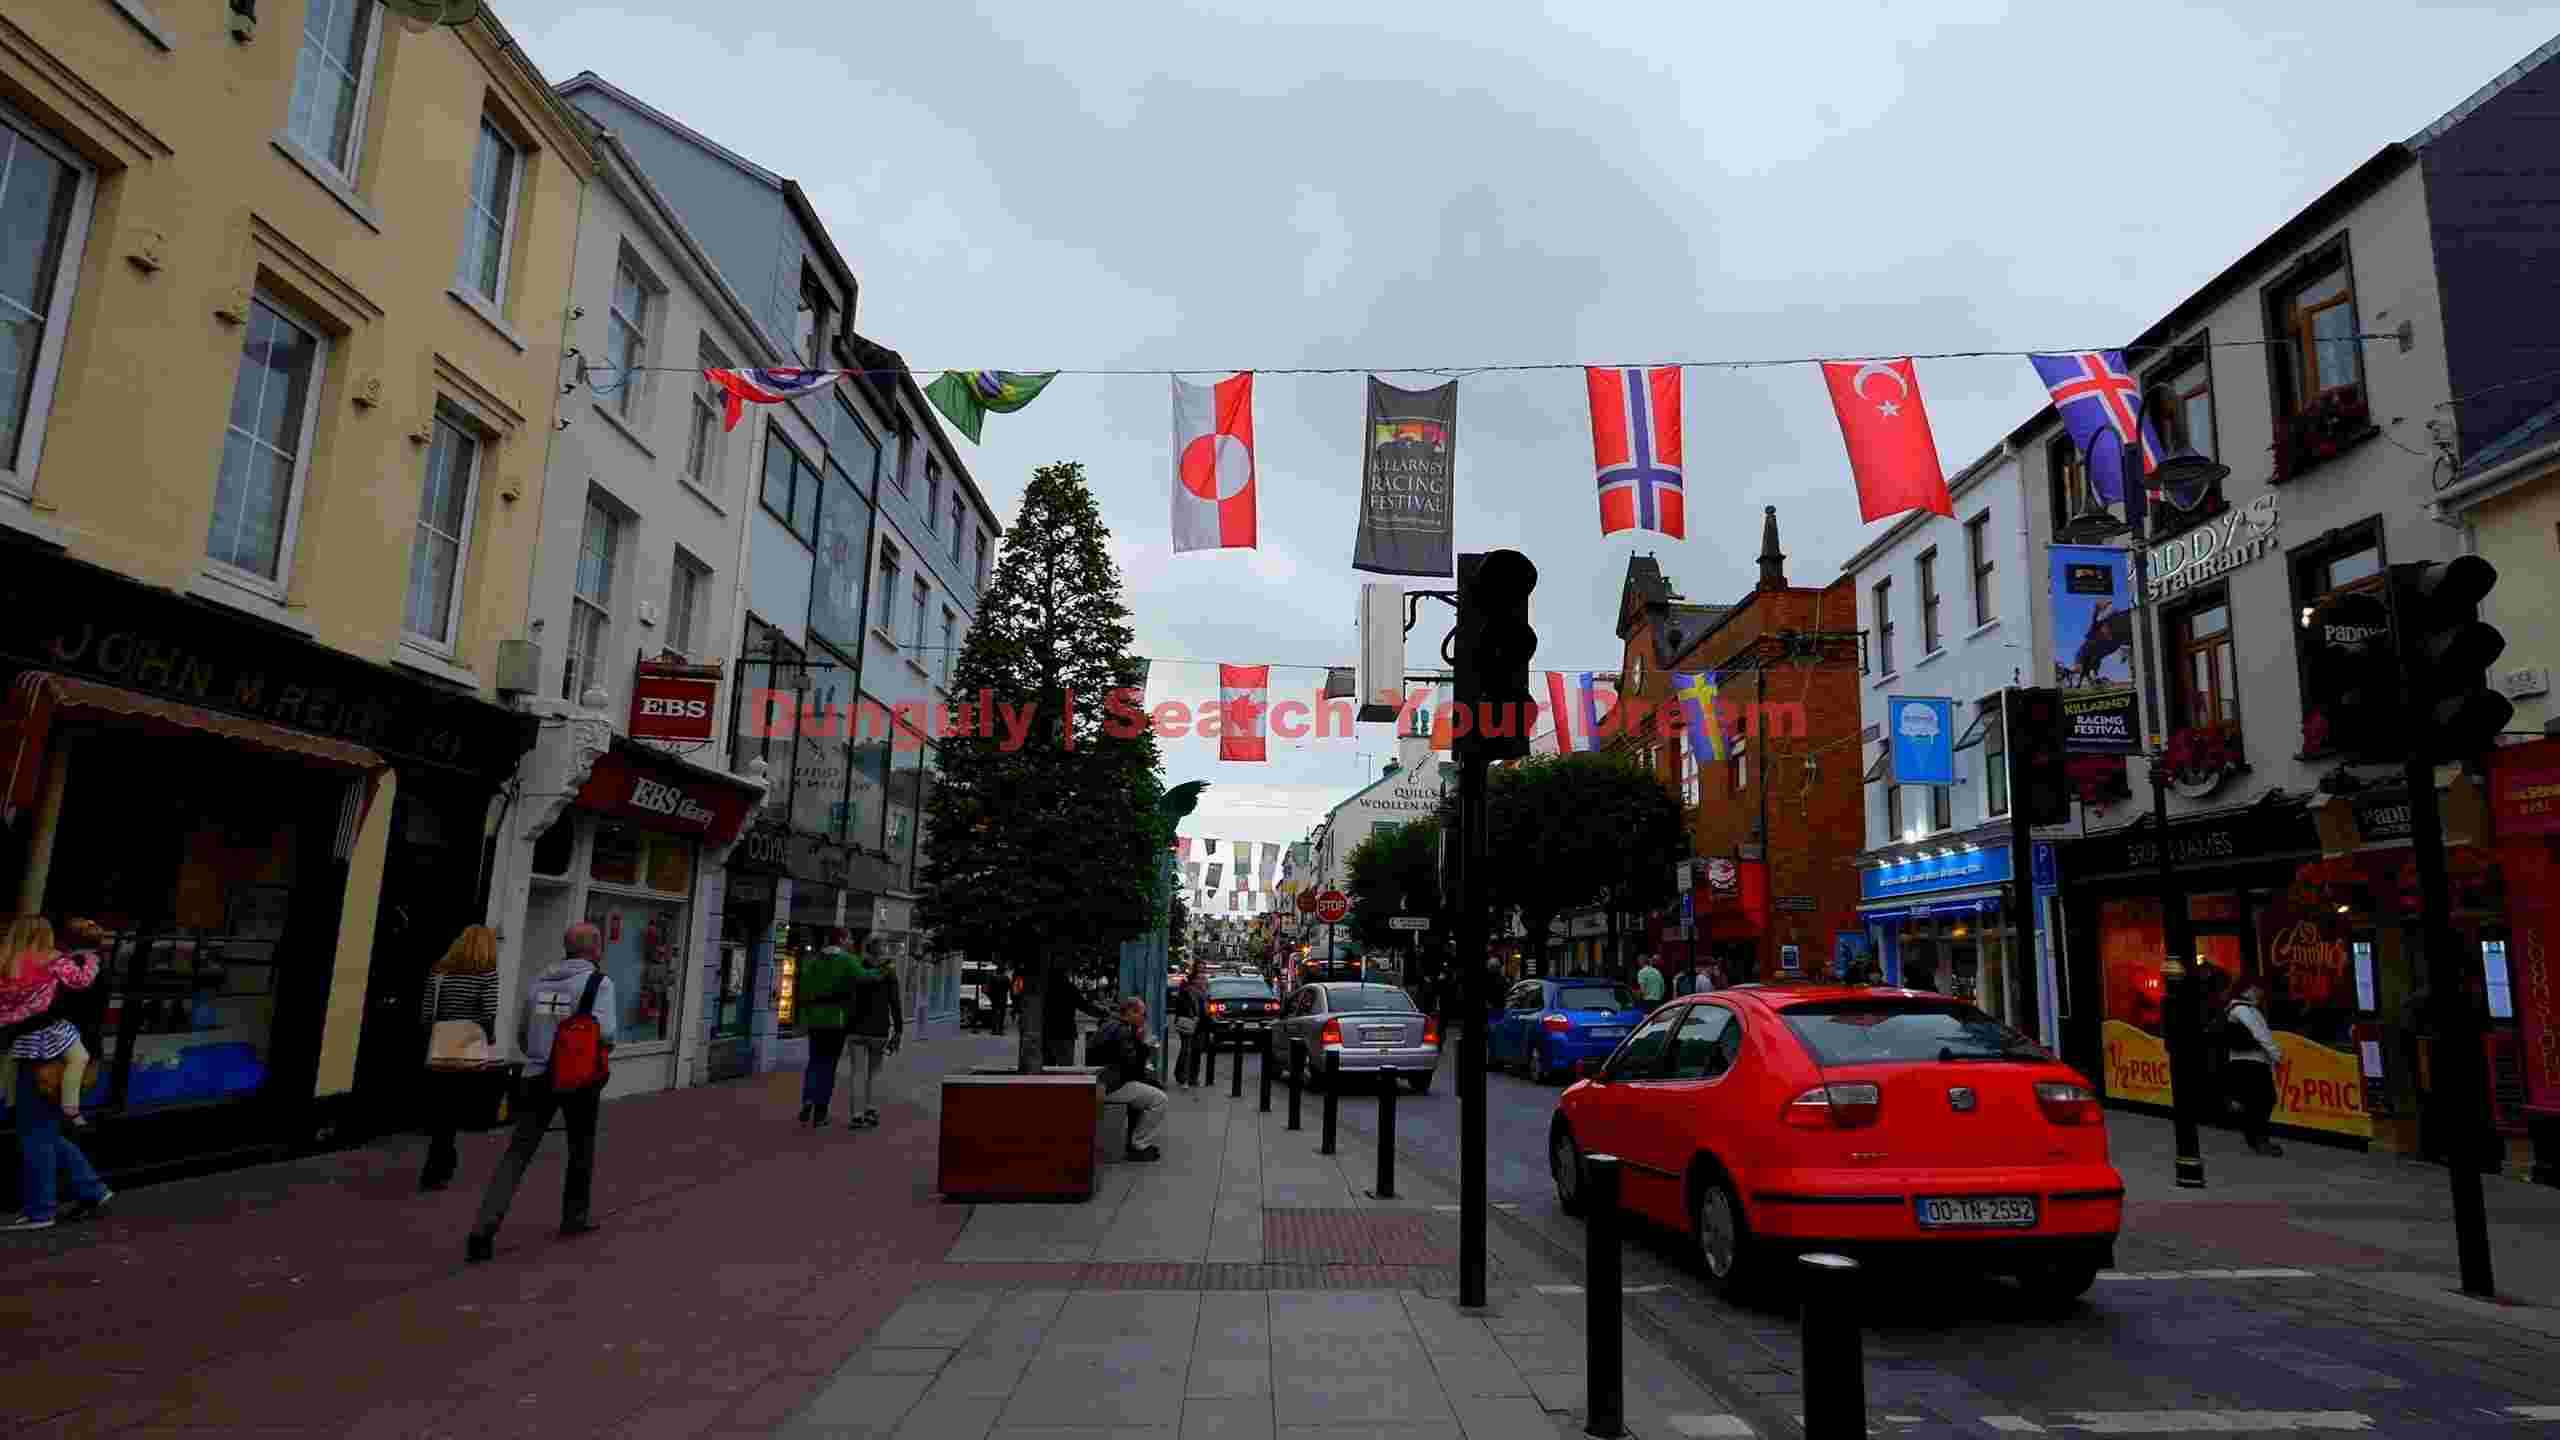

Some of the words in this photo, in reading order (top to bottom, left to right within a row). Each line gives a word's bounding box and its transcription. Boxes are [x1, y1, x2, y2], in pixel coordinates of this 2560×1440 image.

[1372, 458, 1443, 475] KILLARNEY
[1371, 474, 1442, 494] RACING
[1369, 495, 1442, 513] FESTIVAL
[640, 698, 706, 719] EBS
[2076, 715, 2122, 726] RACING
[2073, 725, 2128, 736] FESTIVAL
[628, 777, 681, 817] EBS
[1359, 799, 1417, 812] WOOLLEN
[1319, 899, 1344, 913] STOP
[2129, 1064, 2168, 1089] PRIC
[1928, 1200, 2032, 1220] 00-TN-2592
